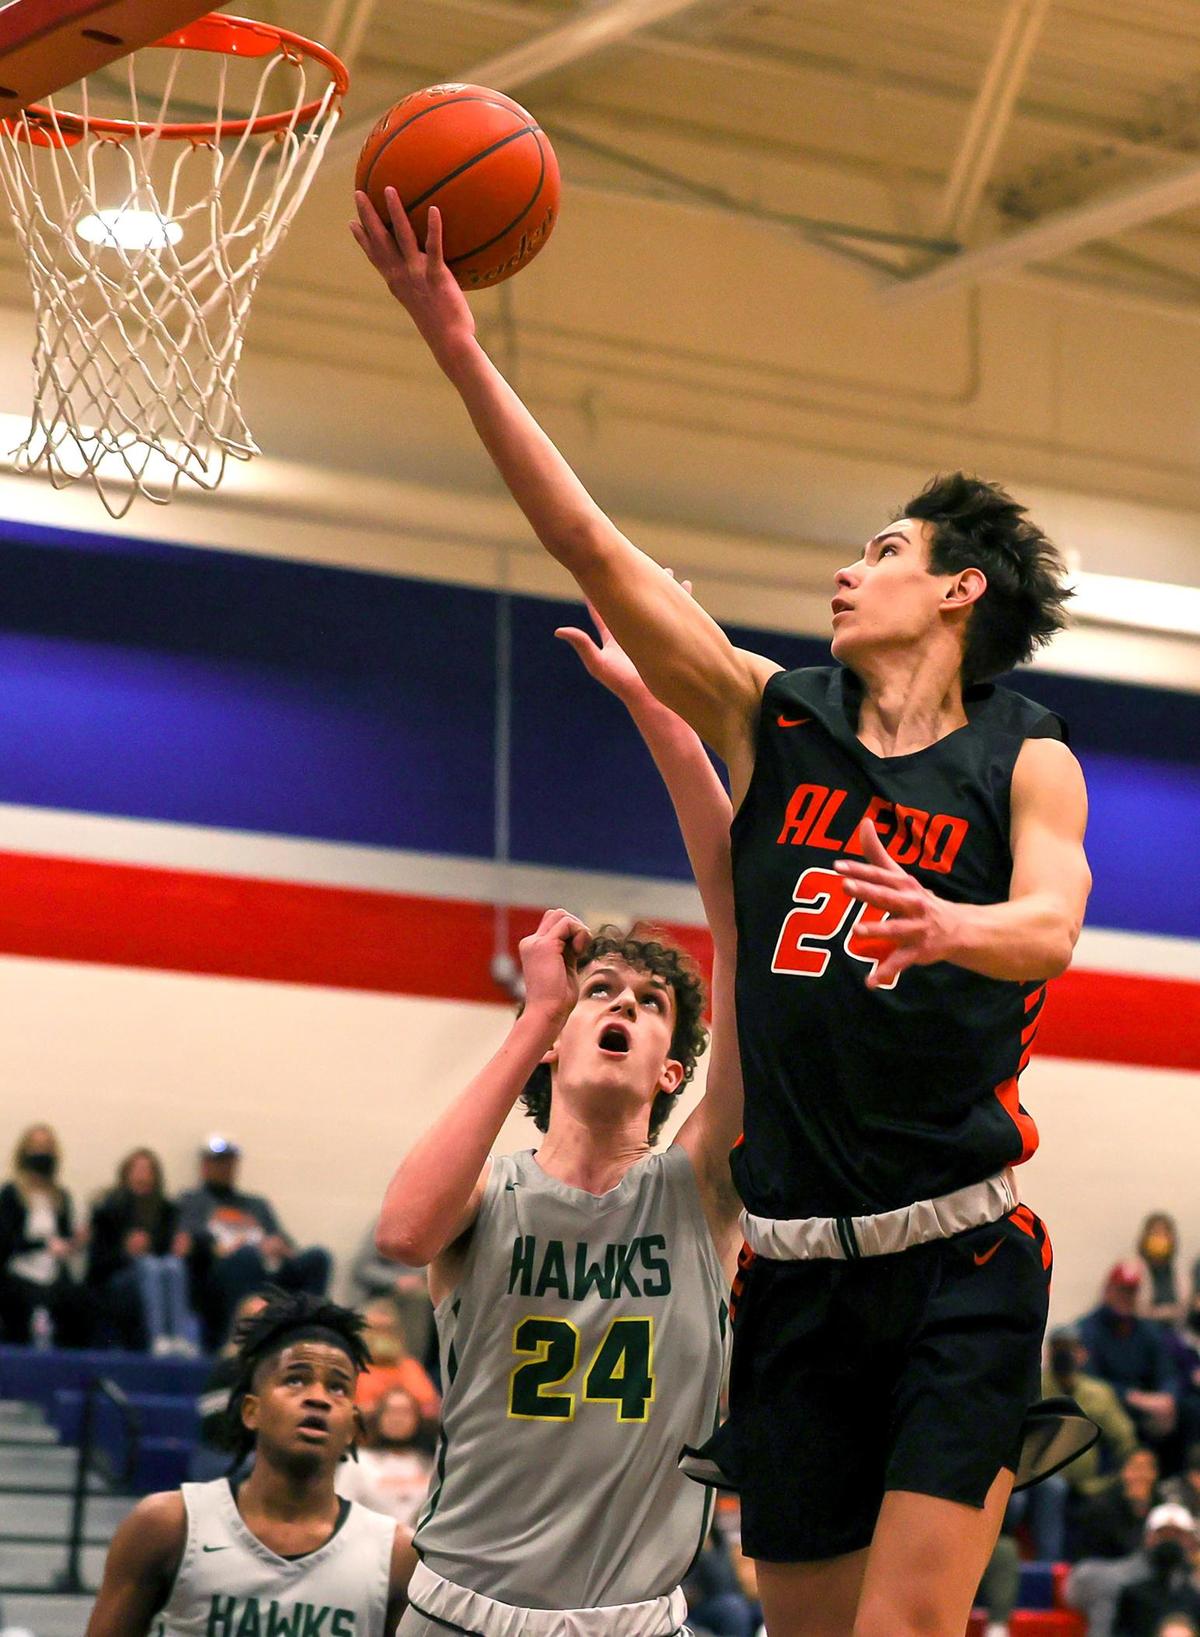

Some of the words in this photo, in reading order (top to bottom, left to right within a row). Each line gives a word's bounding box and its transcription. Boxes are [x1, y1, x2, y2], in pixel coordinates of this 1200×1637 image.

[777, 784, 969, 874] ALEDO
[508, 1234, 671, 1301] HAWKS
[507, 1315, 656, 1424] 24
[206, 1593, 356, 1637] HAWKS
